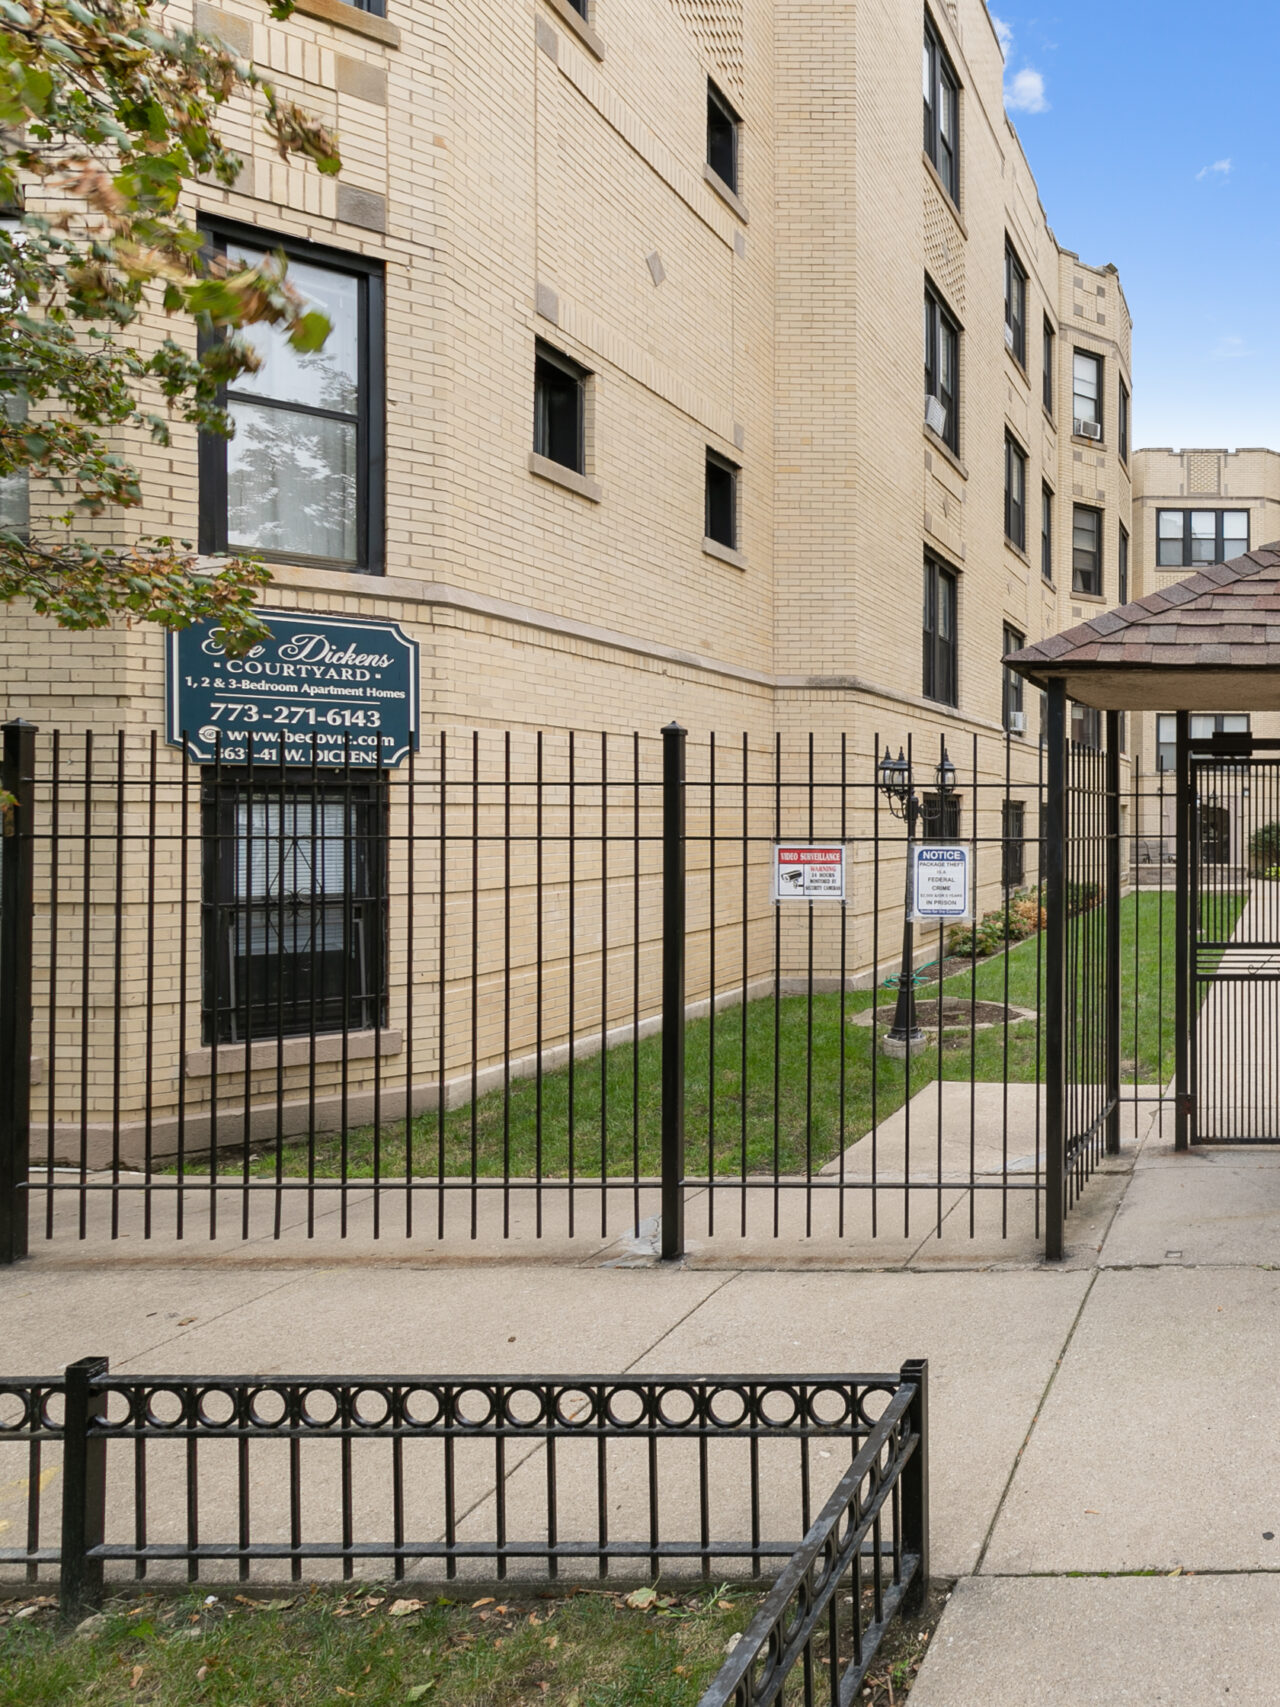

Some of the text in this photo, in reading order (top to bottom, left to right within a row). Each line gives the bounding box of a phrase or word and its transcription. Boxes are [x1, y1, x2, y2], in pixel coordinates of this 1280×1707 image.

[201, 627, 395, 669] Te Dickens
[226, 659, 371, 682] COURTYARD
[185, 676, 406, 699] 1, 2 & 3-Bedroom Apartment Homes
[209, 702, 381, 727] 773-271-6143
[284, 749, 306, 762] W.
[780, 852, 840, 861] VIDEO SURVEILLANCE
[922, 850, 961, 860] NOTICE
